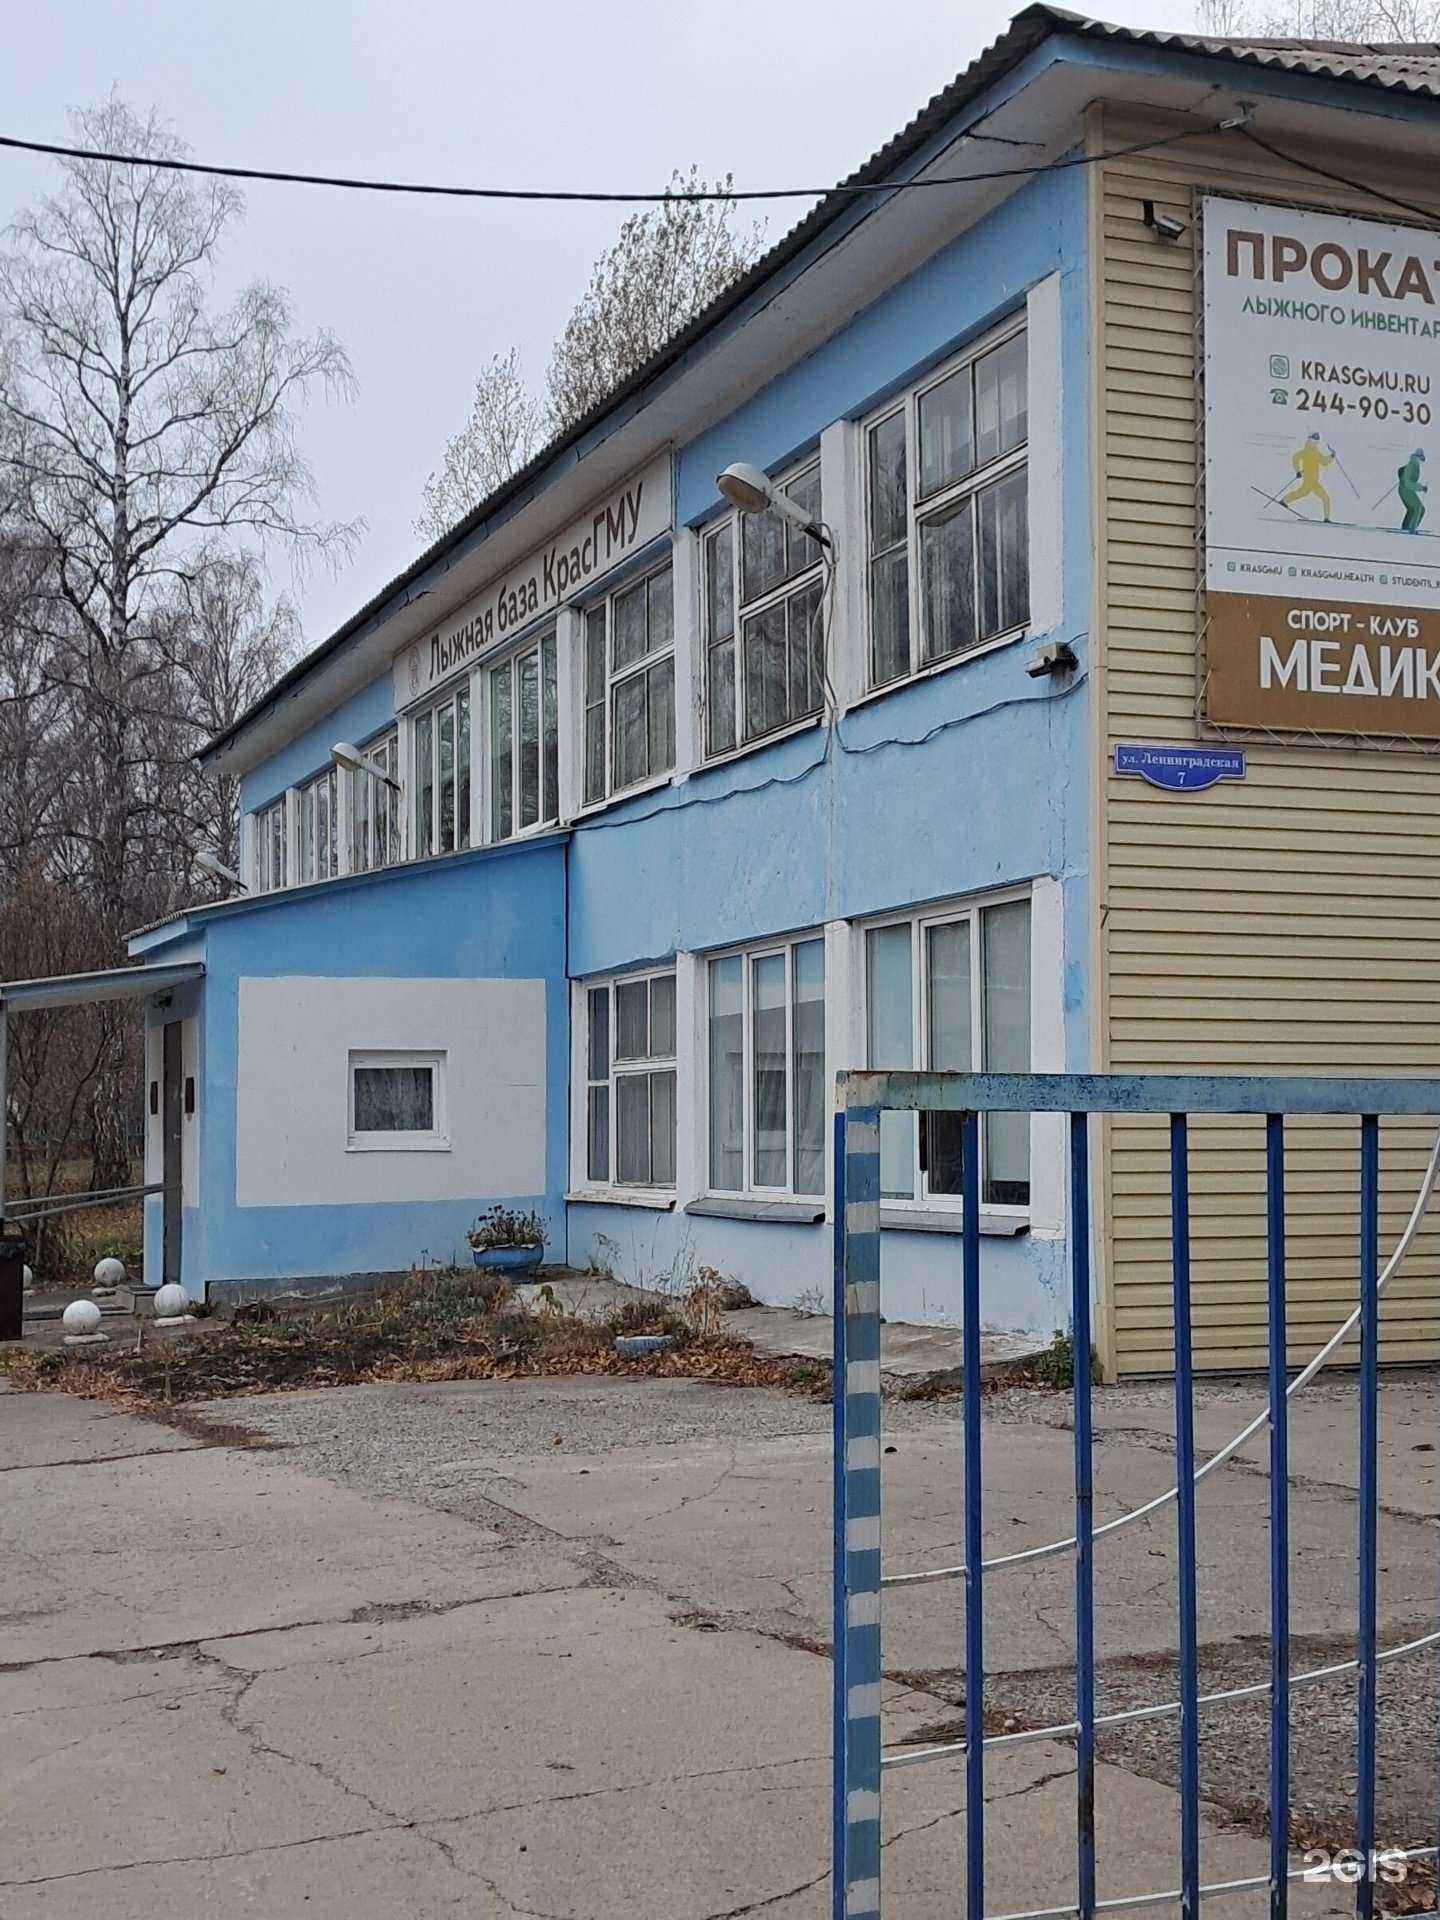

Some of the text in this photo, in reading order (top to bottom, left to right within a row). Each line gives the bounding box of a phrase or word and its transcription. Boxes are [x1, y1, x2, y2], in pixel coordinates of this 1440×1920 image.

[1226, 228, 1440, 305] ПРОКА
[1241, 295, 1345, 325] ЛЫЖНОГО
[1301, 360, 1430, 395] KRASGMU.RU
[1295, 388, 1431, 425] 244-90-30
[428, 605, 494, 681] Лыжная
[497, 575, 539, 632] база
[543, 480, 643, 602] КрасГМУ
[1240, 563, 1283, 575] KRASGMU
[1287, 608, 1352, 634] СПОРТ
[1370, 615, 1419, 639] КЛУБ
[1259, 636, 1440, 700] МЕДИК
[1121, 752, 1240, 769] ул. Ленинградская
[1176, 771, 1187, 785] 7
